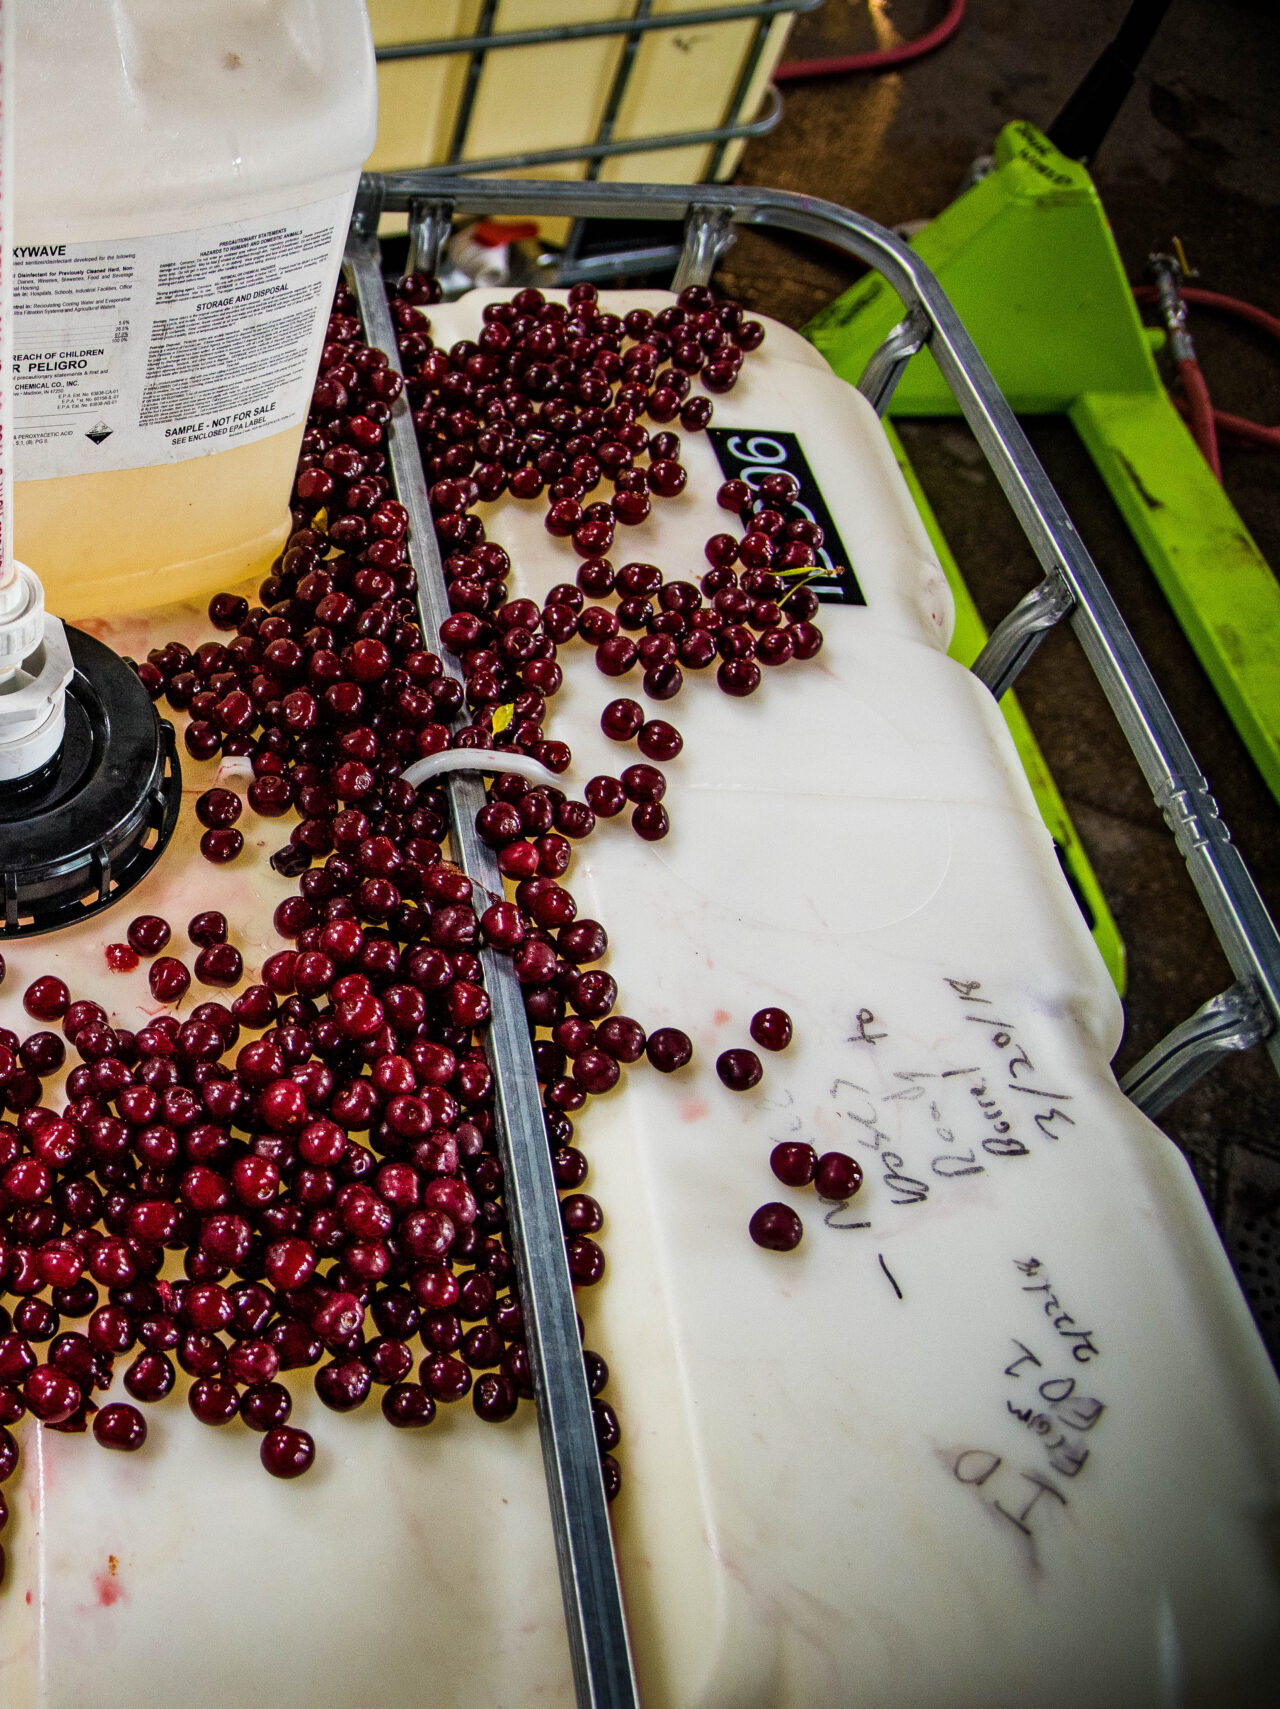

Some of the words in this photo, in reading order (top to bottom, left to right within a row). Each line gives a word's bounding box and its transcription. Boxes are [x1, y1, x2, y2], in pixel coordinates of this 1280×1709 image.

[200, 249, 223, 257] HAZARDS
[230, 243, 250, 252] HUMANS
[260, 235, 283, 245] DOMESTIC
[283, 230, 303, 239] ANIMALS
[219, 234, 257, 247] PRECAUTIONARY
[258, 228, 287, 239] STATEMENTS
[13, 245, 66, 258] XYWAVE
[196, 295, 234, 312] STORAGE
[235, 292, 252, 304] AND
[253, 283, 289, 299] DISPOSAL
[44, 352, 57, 360] OF
[59, 349, 104, 359] CHILDREN
[28, 359, 87, 372] PELIGRO
[17, 373, 53, 381] precautionary
[54, 370, 82, 378] statements
[15, 382, 49, 390] CHEMICAL
[165, 422, 204, 438] SAMPLE
[212, 416, 231, 429] NOT
[233, 410, 251, 423] FOR
[253, 401, 276, 417] SALE
[18, 432, 59, 440] PEROXYACETIC
[172, 436, 187, 446] SEE
[188, 427, 228, 443] ENCLOSED
[229, 424, 243, 433] EPA
[245, 416, 267, 429] LABEL
[942, 977, 1076, 1141] 3/20/18
[941, 1066, 1030, 1156] Barrel
